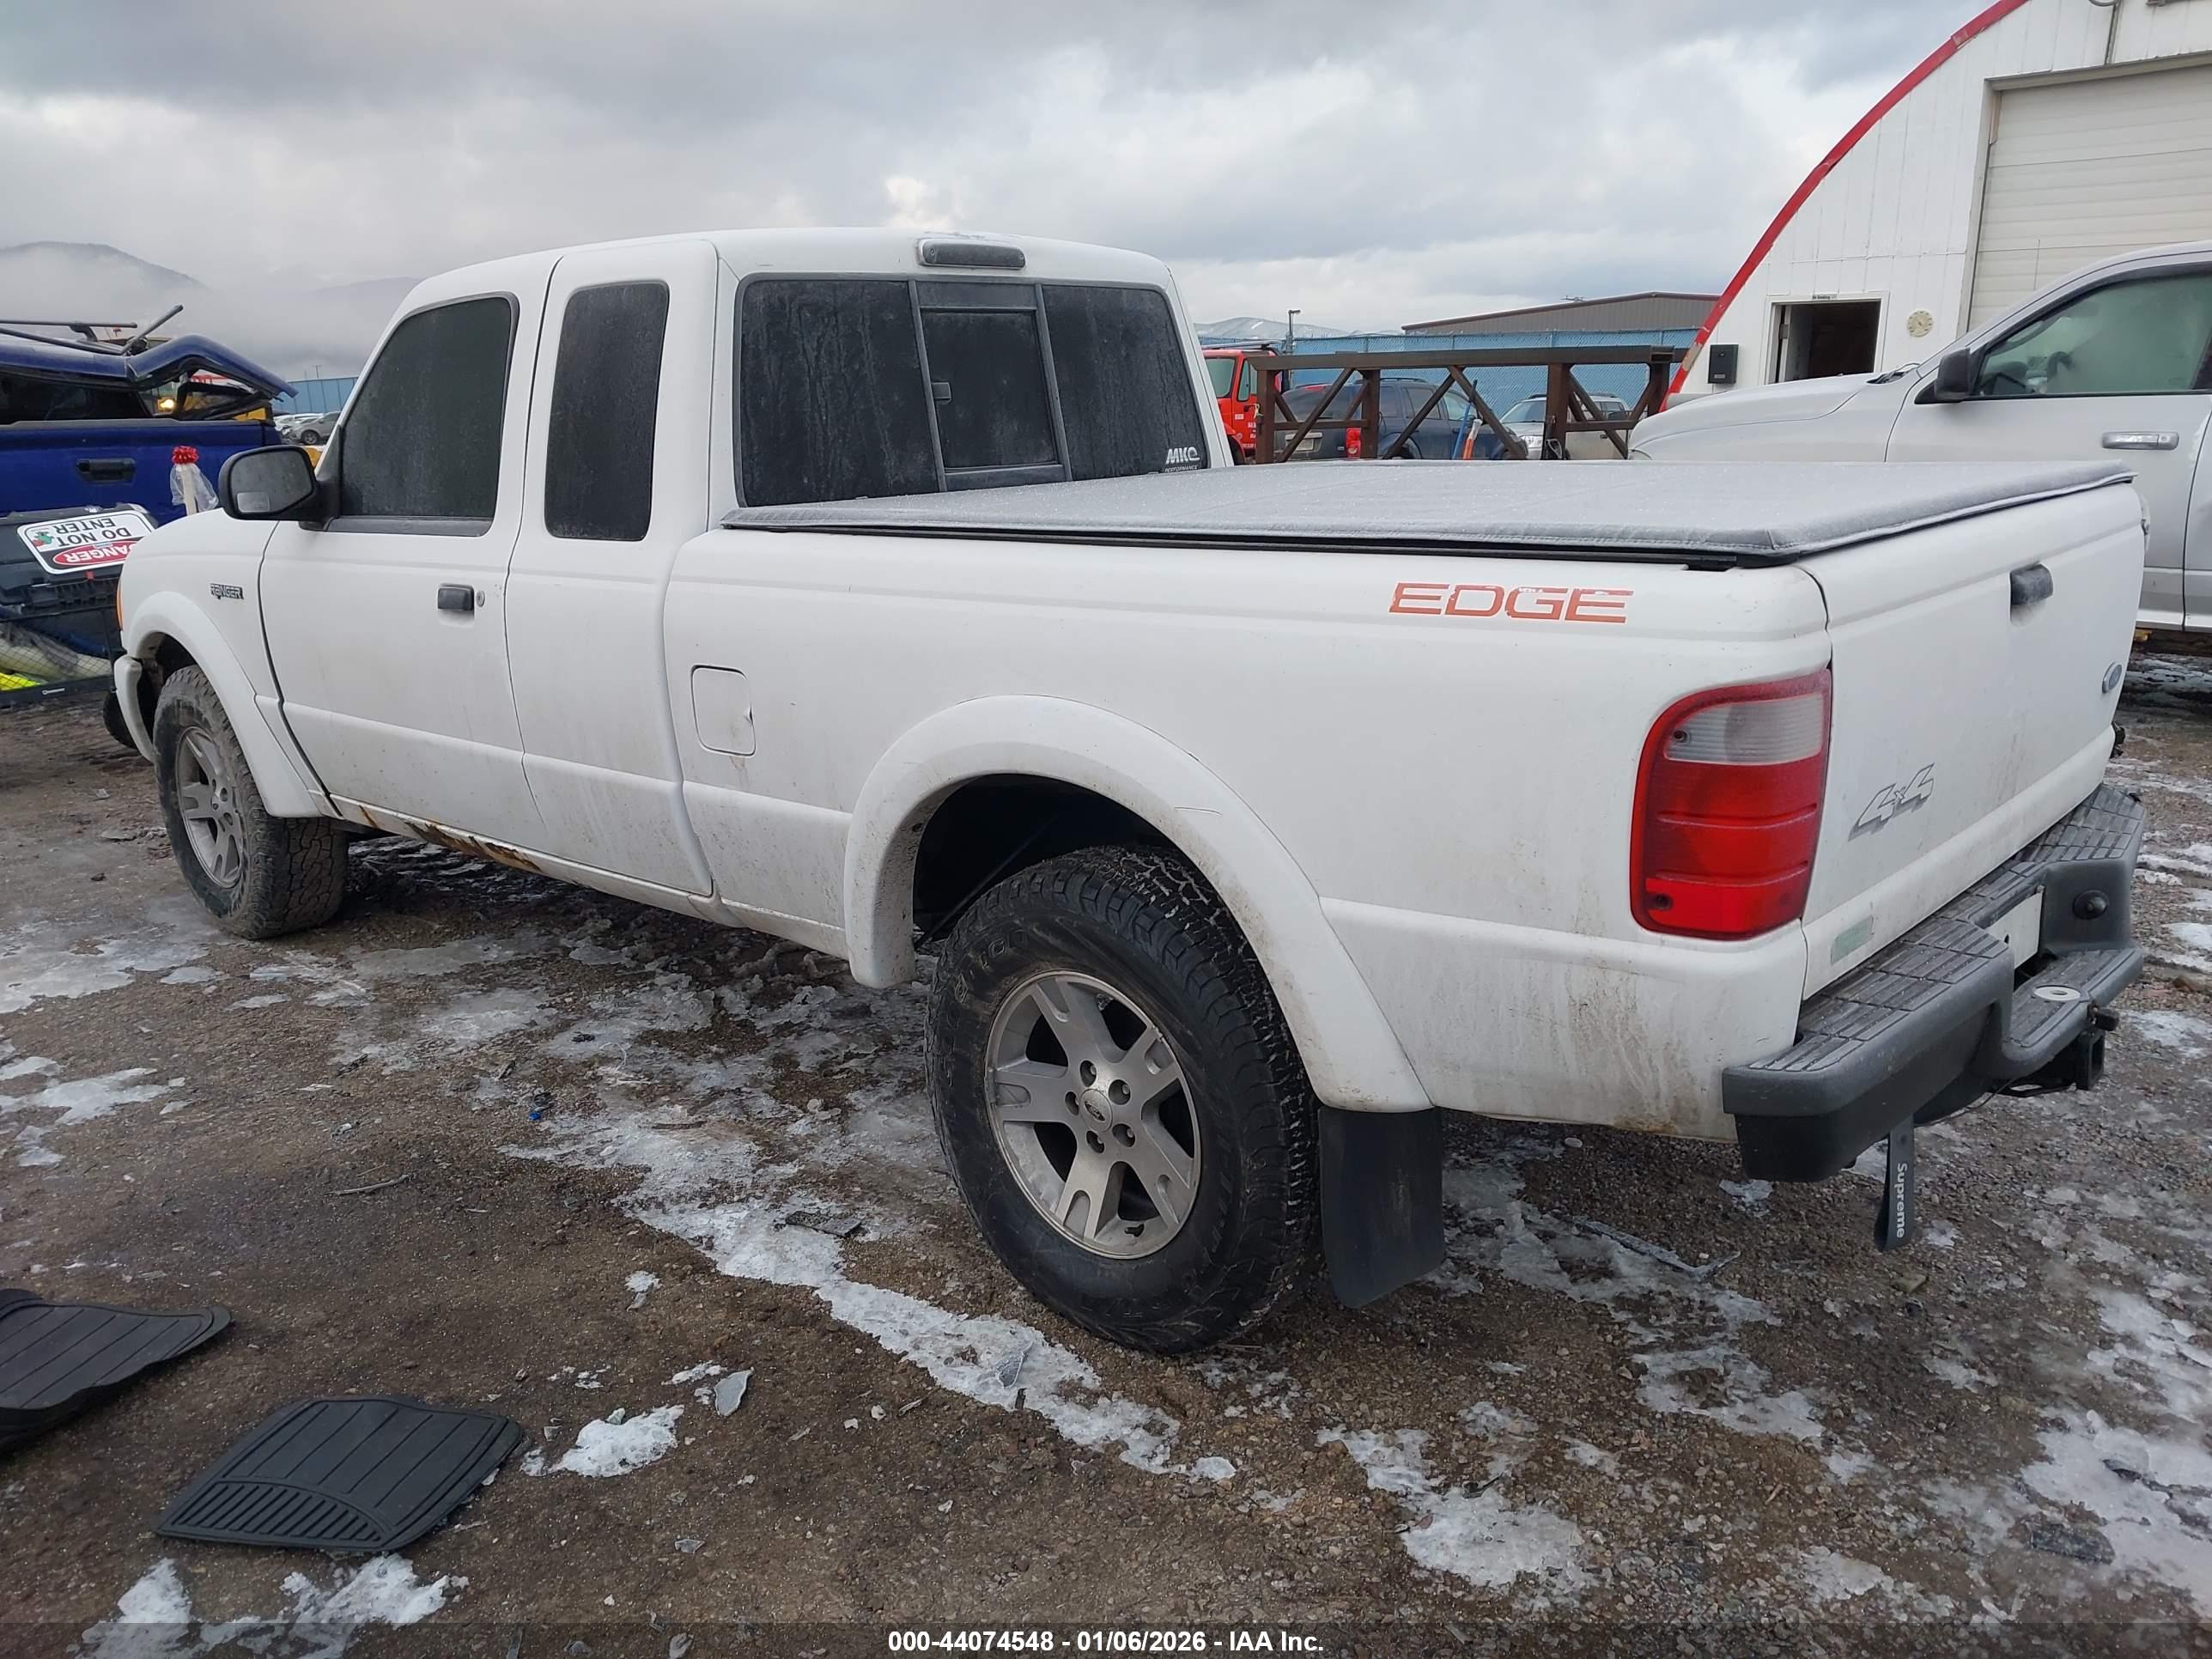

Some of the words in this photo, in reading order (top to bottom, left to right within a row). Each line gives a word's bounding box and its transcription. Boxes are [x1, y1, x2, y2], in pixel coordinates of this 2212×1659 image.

[52, 518, 116, 534] ENTER
[102, 527, 131, 539] DO
[57, 532, 97, 547] NOT
[64, 544, 136, 562] ANGER
[1389, 582, 1634, 623] EDGE
[1894, 1163, 1908, 1238] Supreme
